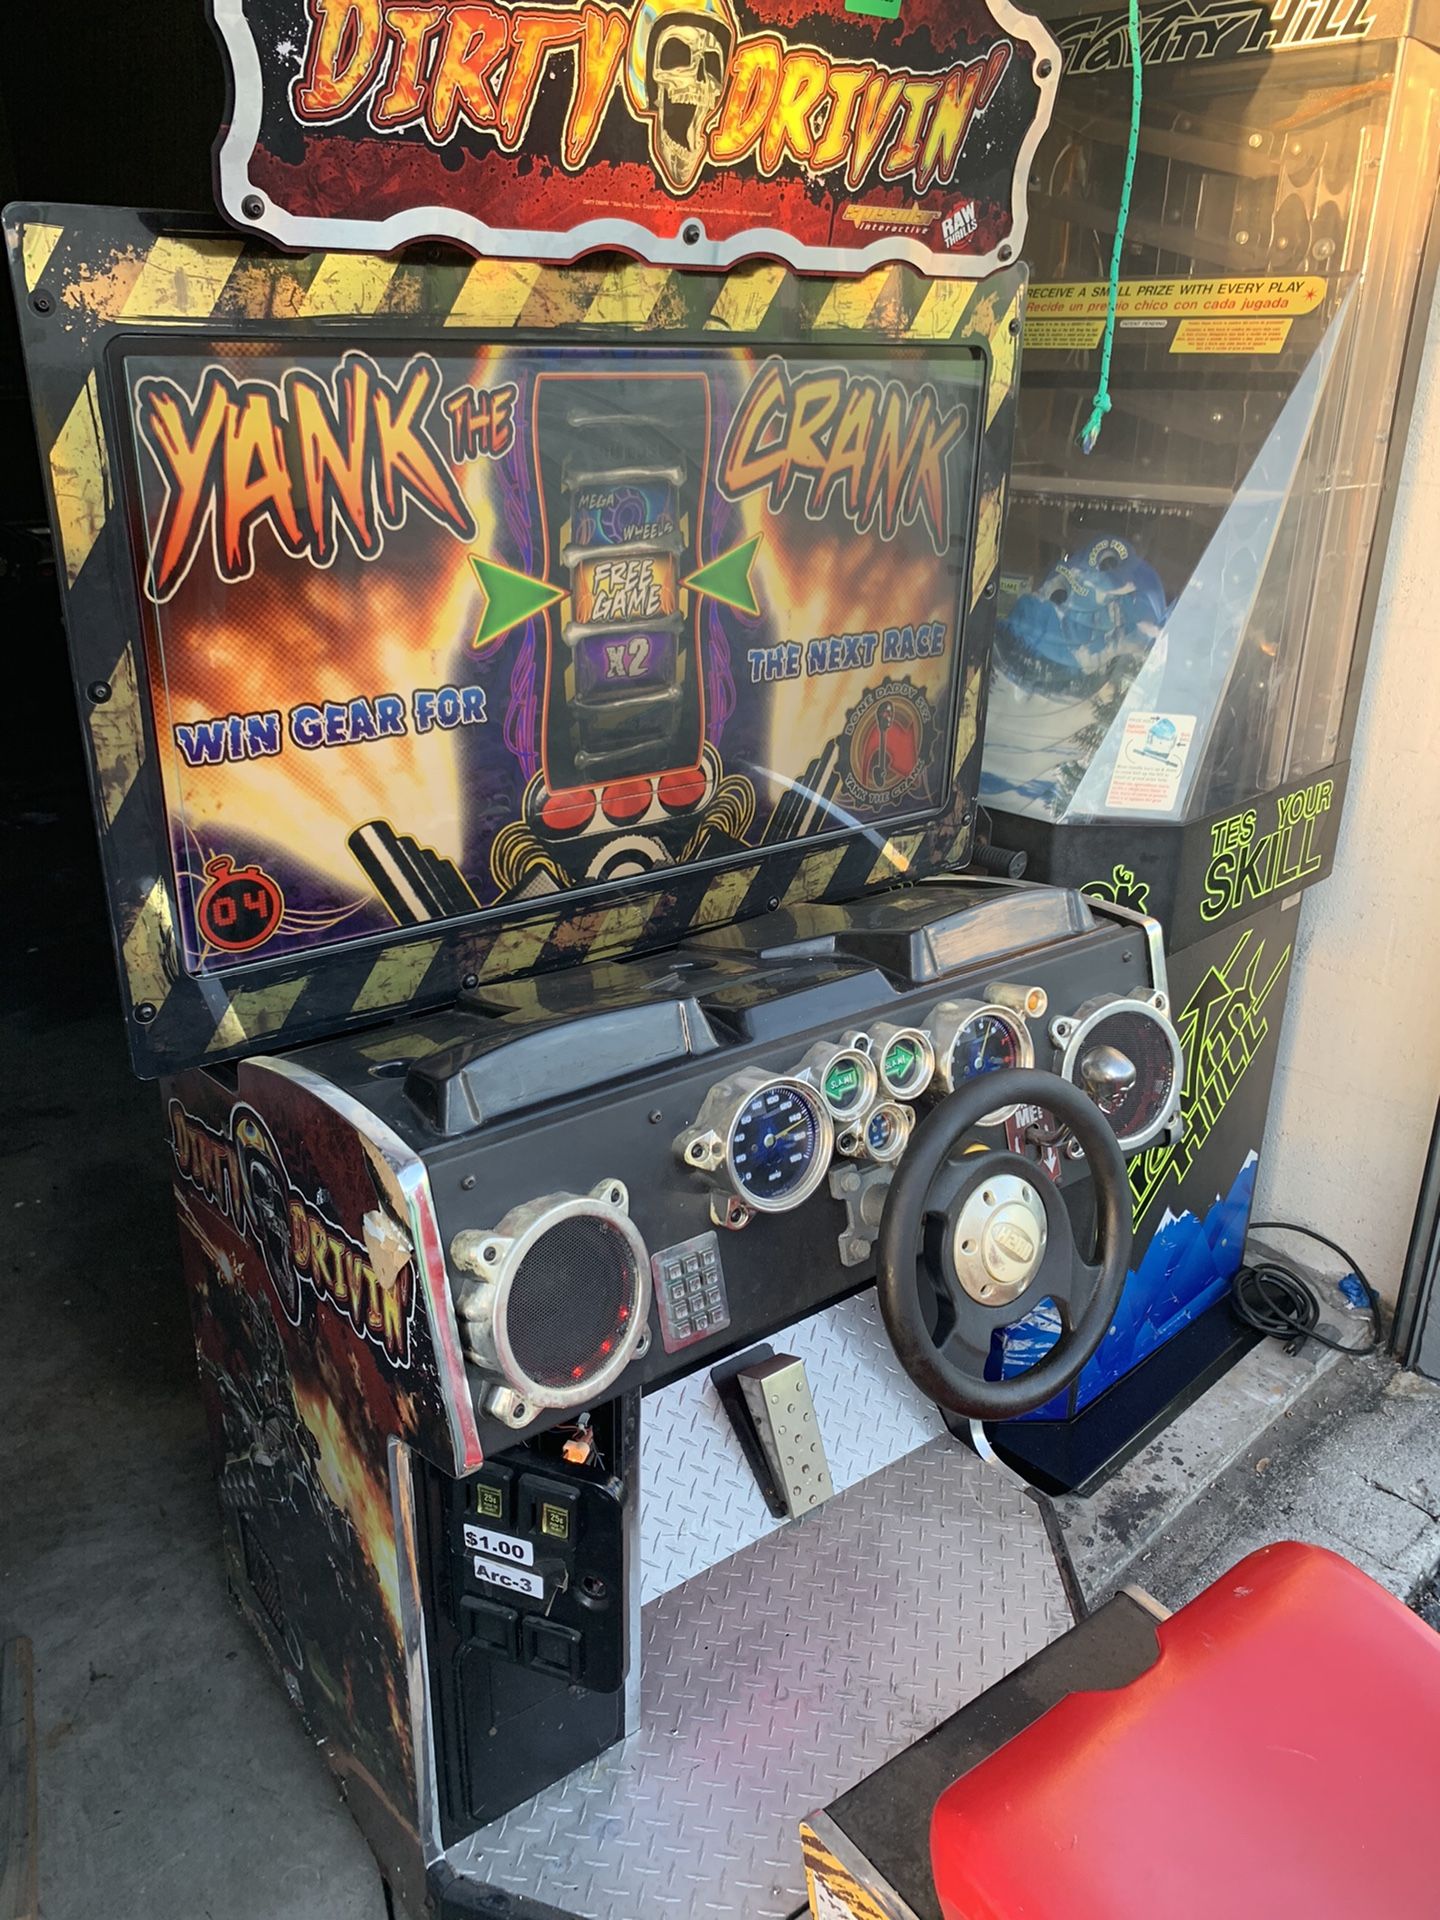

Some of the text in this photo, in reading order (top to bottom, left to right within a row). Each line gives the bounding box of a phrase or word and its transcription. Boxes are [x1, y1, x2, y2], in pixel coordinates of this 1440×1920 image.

[292, 0, 632, 170] DIRTY
[941, 201, 975, 239] RAW
[944, 218, 979, 249] THRILLS
[1027, 280, 1305, 299] RECEIVE A SMLL PRIZE WITH EVERY PLAY
[1069, 303, 1085, 312] un
[1087, 301, 1129, 313] preio
[1134, 299, 1169, 311] chico
[1174, 300, 1198, 311] con
[1203, 299, 1237, 310] cada
[1240, 297, 1290, 311] jugada
[717, 355, 969, 554] CRANK
[142, 352, 517, 602] YANK THE
[577, 493, 616, 510] MEGA
[622, 522, 674, 542] WHEELS
[593, 559, 655, 596] FREE
[591, 583, 663, 622] GAME
[747, 621, 948, 683] THE NEXT RACE
[177, 684, 488, 768] WIN GEAR FOR
[1277, 779, 1334, 829] YOUR
[1200, 816, 1322, 922] SKILL
[464, 1531, 525, 1560] $1.00
[475, 1564, 533, 1593] Arc-3
